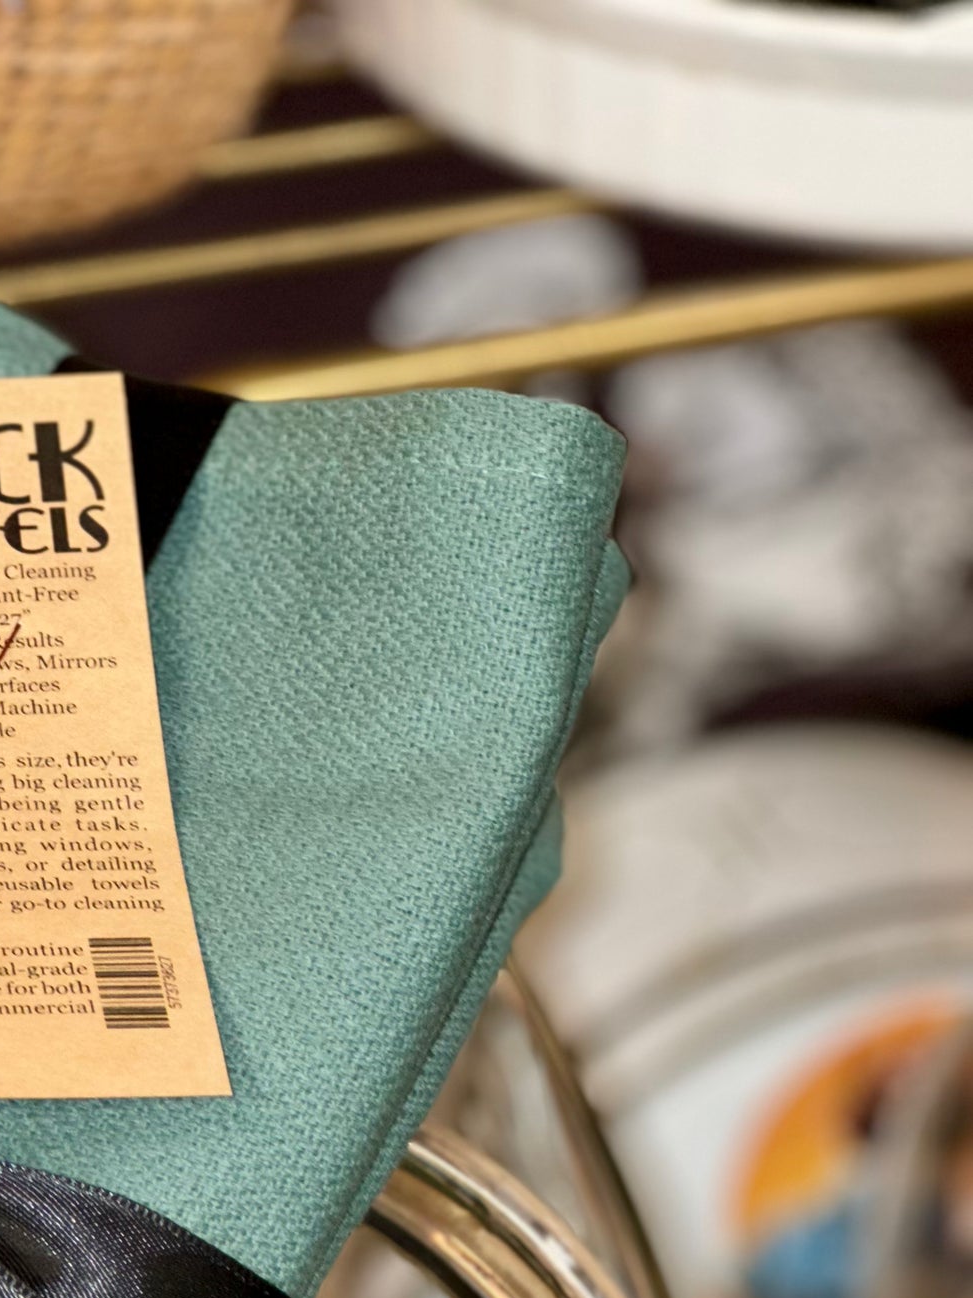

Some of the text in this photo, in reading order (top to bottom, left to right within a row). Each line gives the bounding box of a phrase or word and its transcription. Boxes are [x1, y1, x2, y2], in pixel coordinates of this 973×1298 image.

[4, 564, 96, 580] Cleaning
[38, 655, 117, 669] Mirrors
[16, 752, 62, 770] size,
[66, 751, 139, 769] they're
[12, 774, 46, 792] big
[53, 773, 142, 791] cleaning
[75, 796, 144, 813] gentle
[77, 816, 148, 831] tasks.
[39, 838, 152, 854] windows,
[26, 859, 49, 872] or
[61, 857, 157, 874] detailing
[92, 876, 160, 890] towels
[10, 897, 66, 913] go-to
[74, 896, 165, 912] cleaning
[1, 943, 84, 957] routine
[7, 981, 40, 996] for
[42, 980, 91, 995] both
